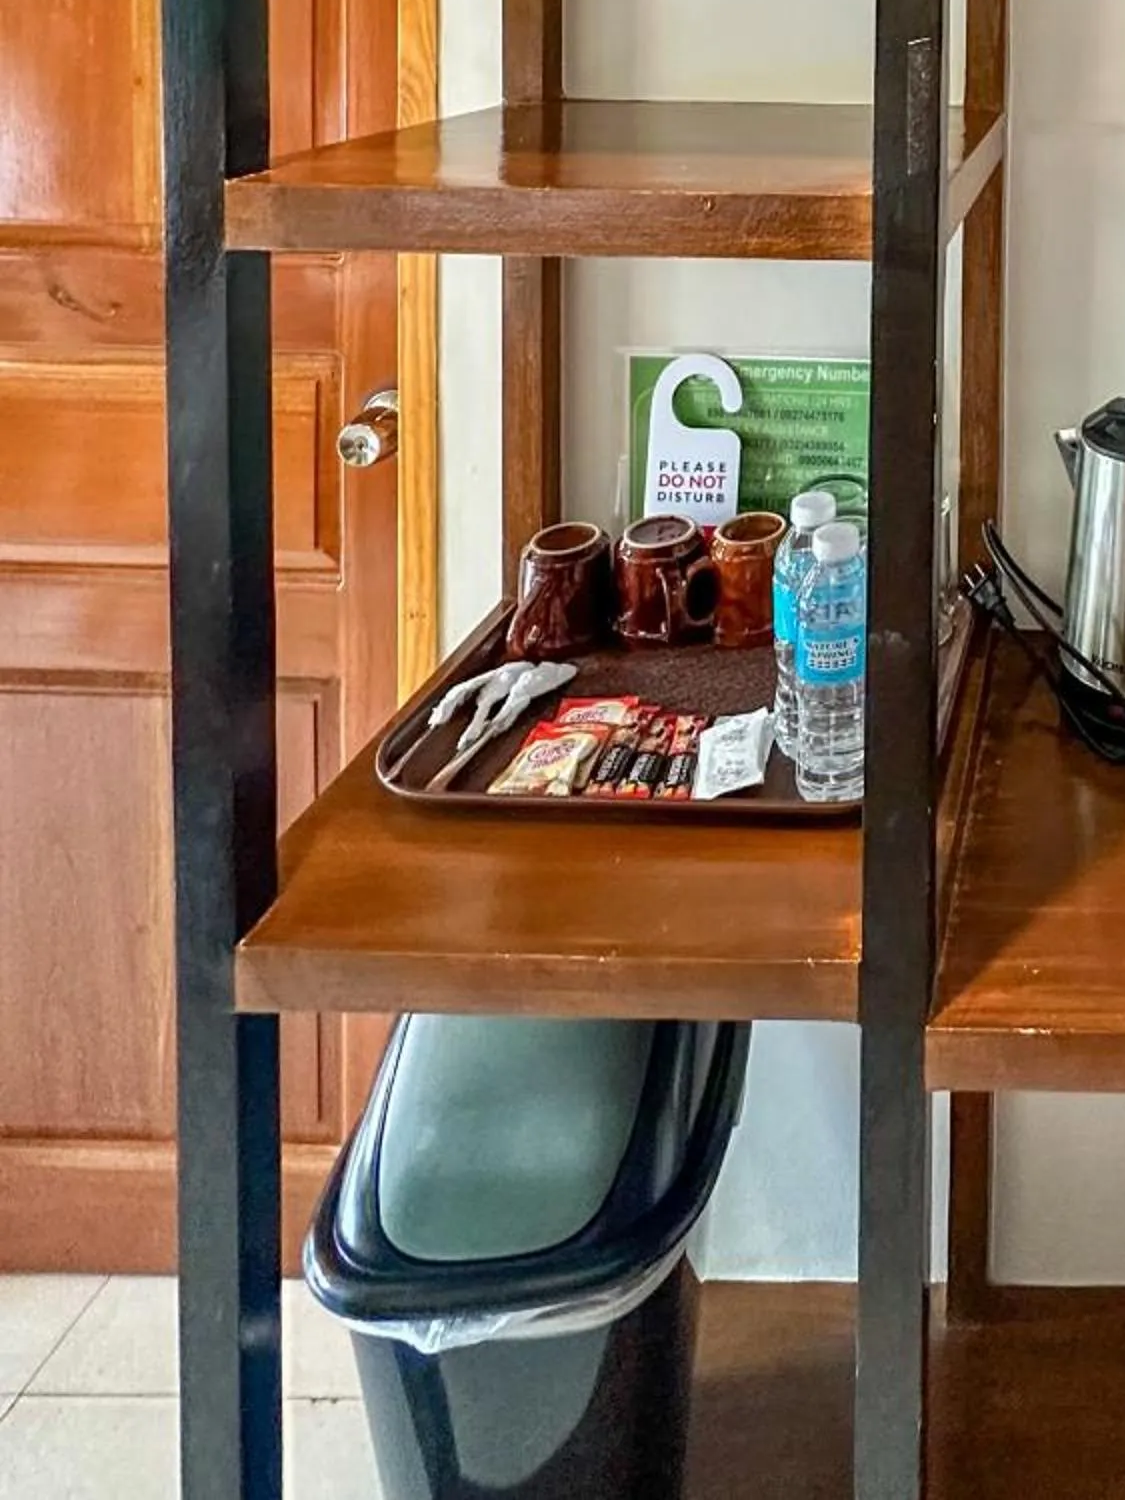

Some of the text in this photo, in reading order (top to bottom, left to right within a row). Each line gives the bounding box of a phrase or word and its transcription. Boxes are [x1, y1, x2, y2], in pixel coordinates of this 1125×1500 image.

[737, 365, 814, 385] mergency
[659, 460, 727, 473] PLEASE
[659, 473, 727, 489] DO NOT
[657, 491, 725, 503] DISTURB
